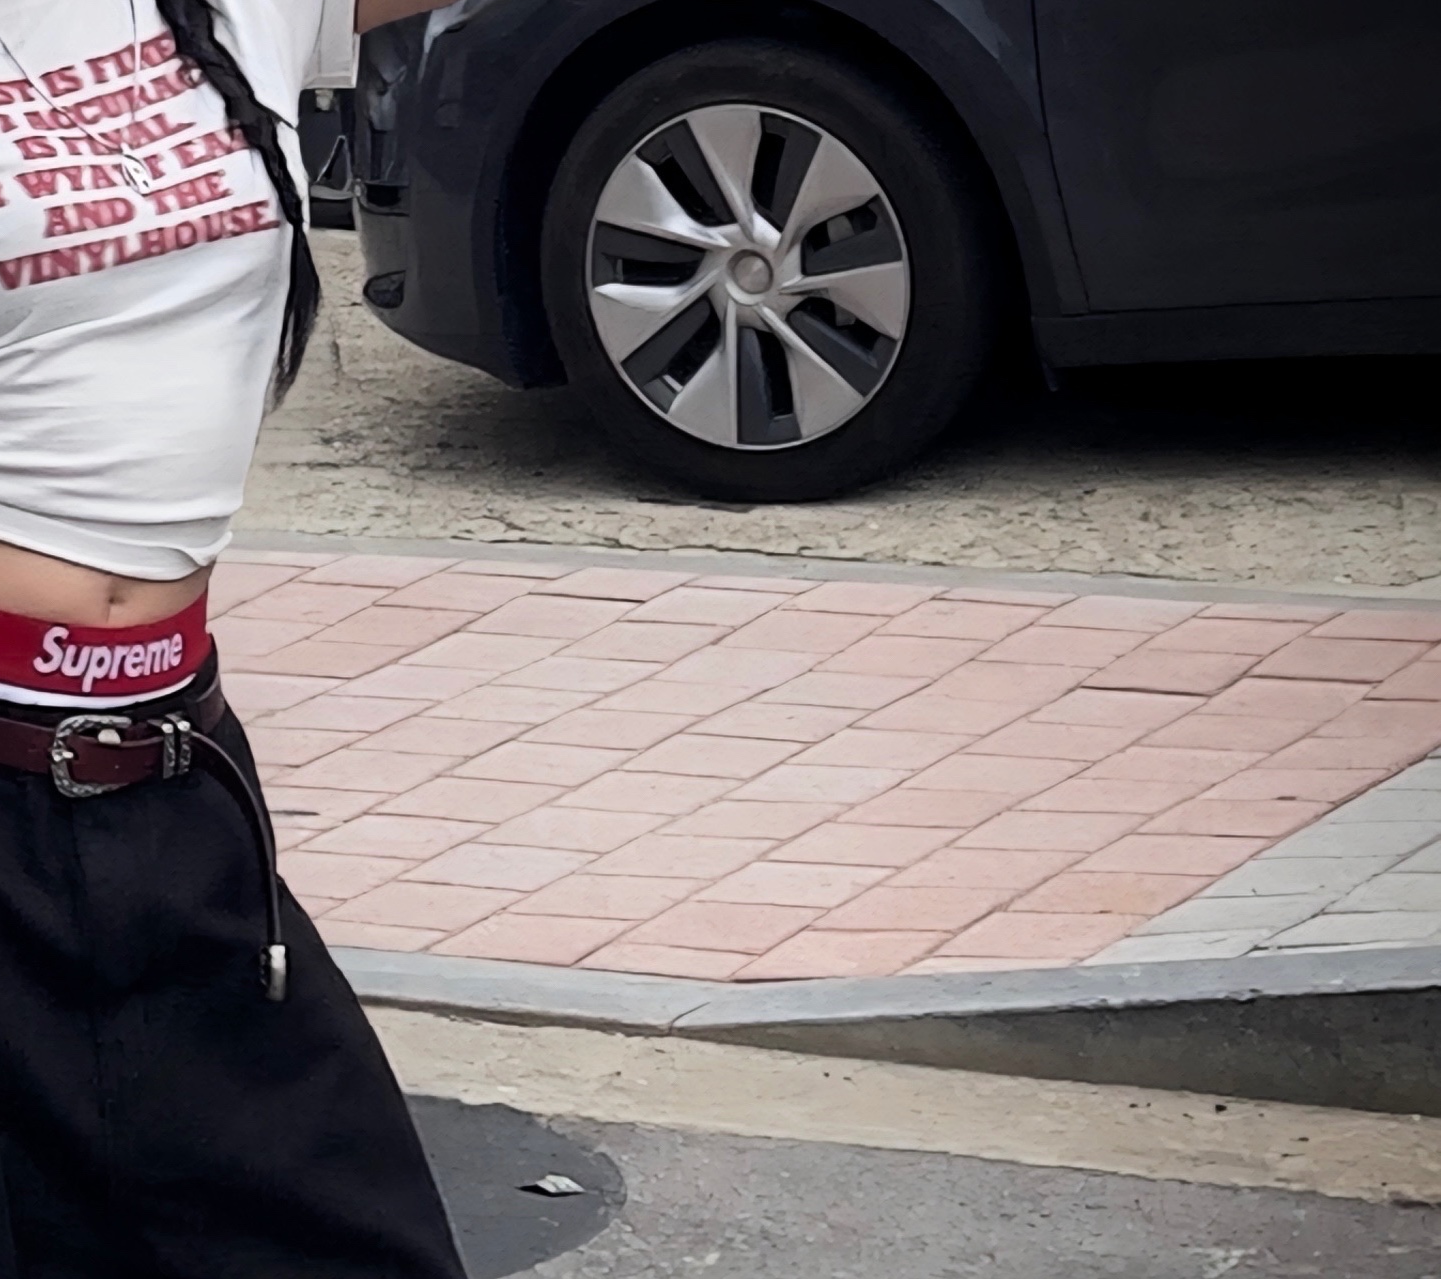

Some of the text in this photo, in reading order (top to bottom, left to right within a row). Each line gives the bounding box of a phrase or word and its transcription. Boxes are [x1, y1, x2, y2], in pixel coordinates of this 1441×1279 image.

[39, 64, 84, 99] IS
[13, 135, 58, 160] IS
[43, 168, 234, 239] AND THE
[32, 625, 184, 693] Supreme
